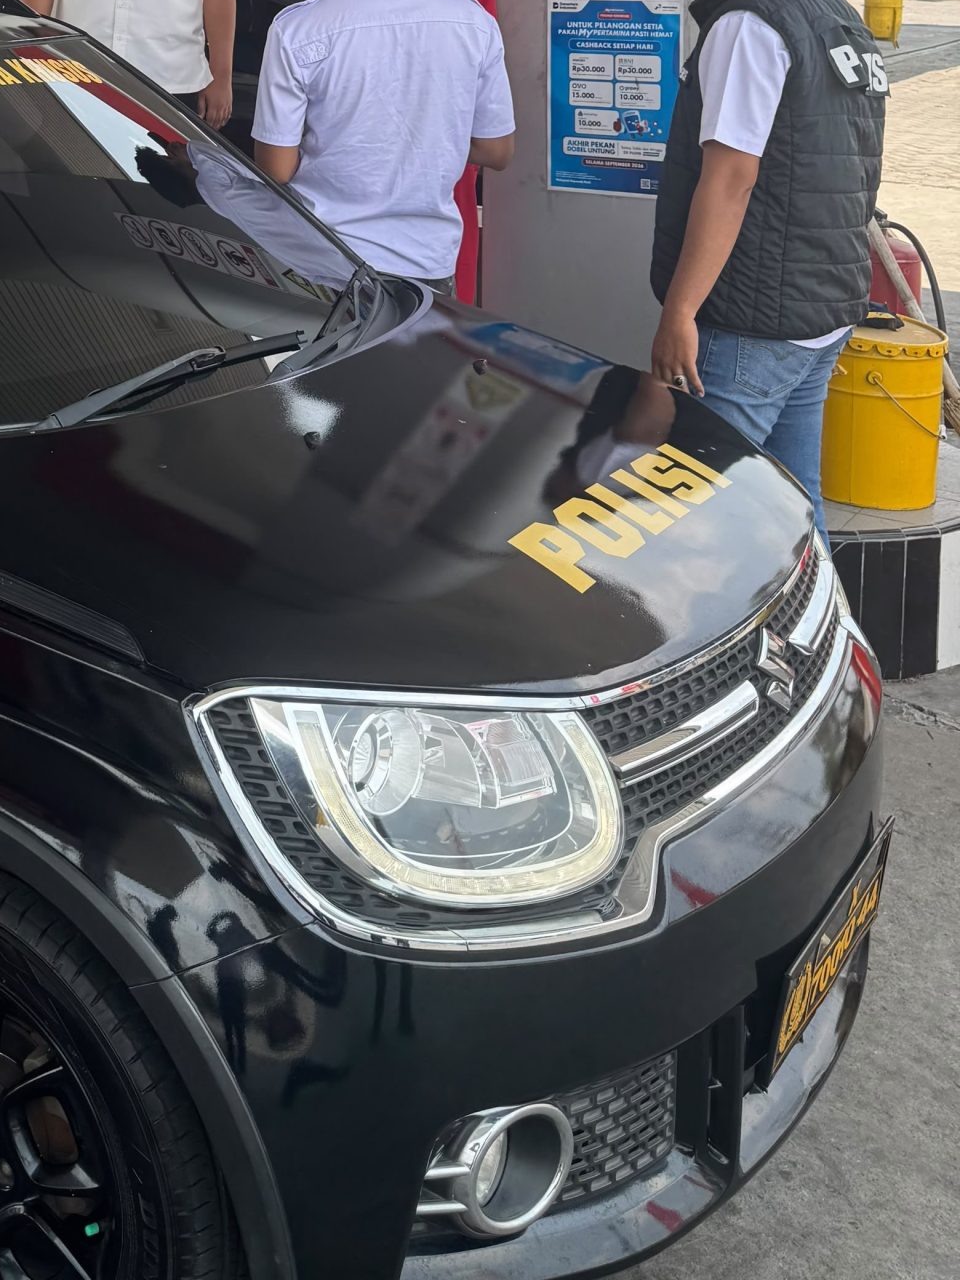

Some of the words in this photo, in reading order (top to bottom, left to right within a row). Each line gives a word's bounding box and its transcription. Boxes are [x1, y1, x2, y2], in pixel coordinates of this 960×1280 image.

[595, 22, 641, 30] PELANGGAN
[572, 65, 605, 73] Rp30.000
[507, 443, 733, 594] POLISI
